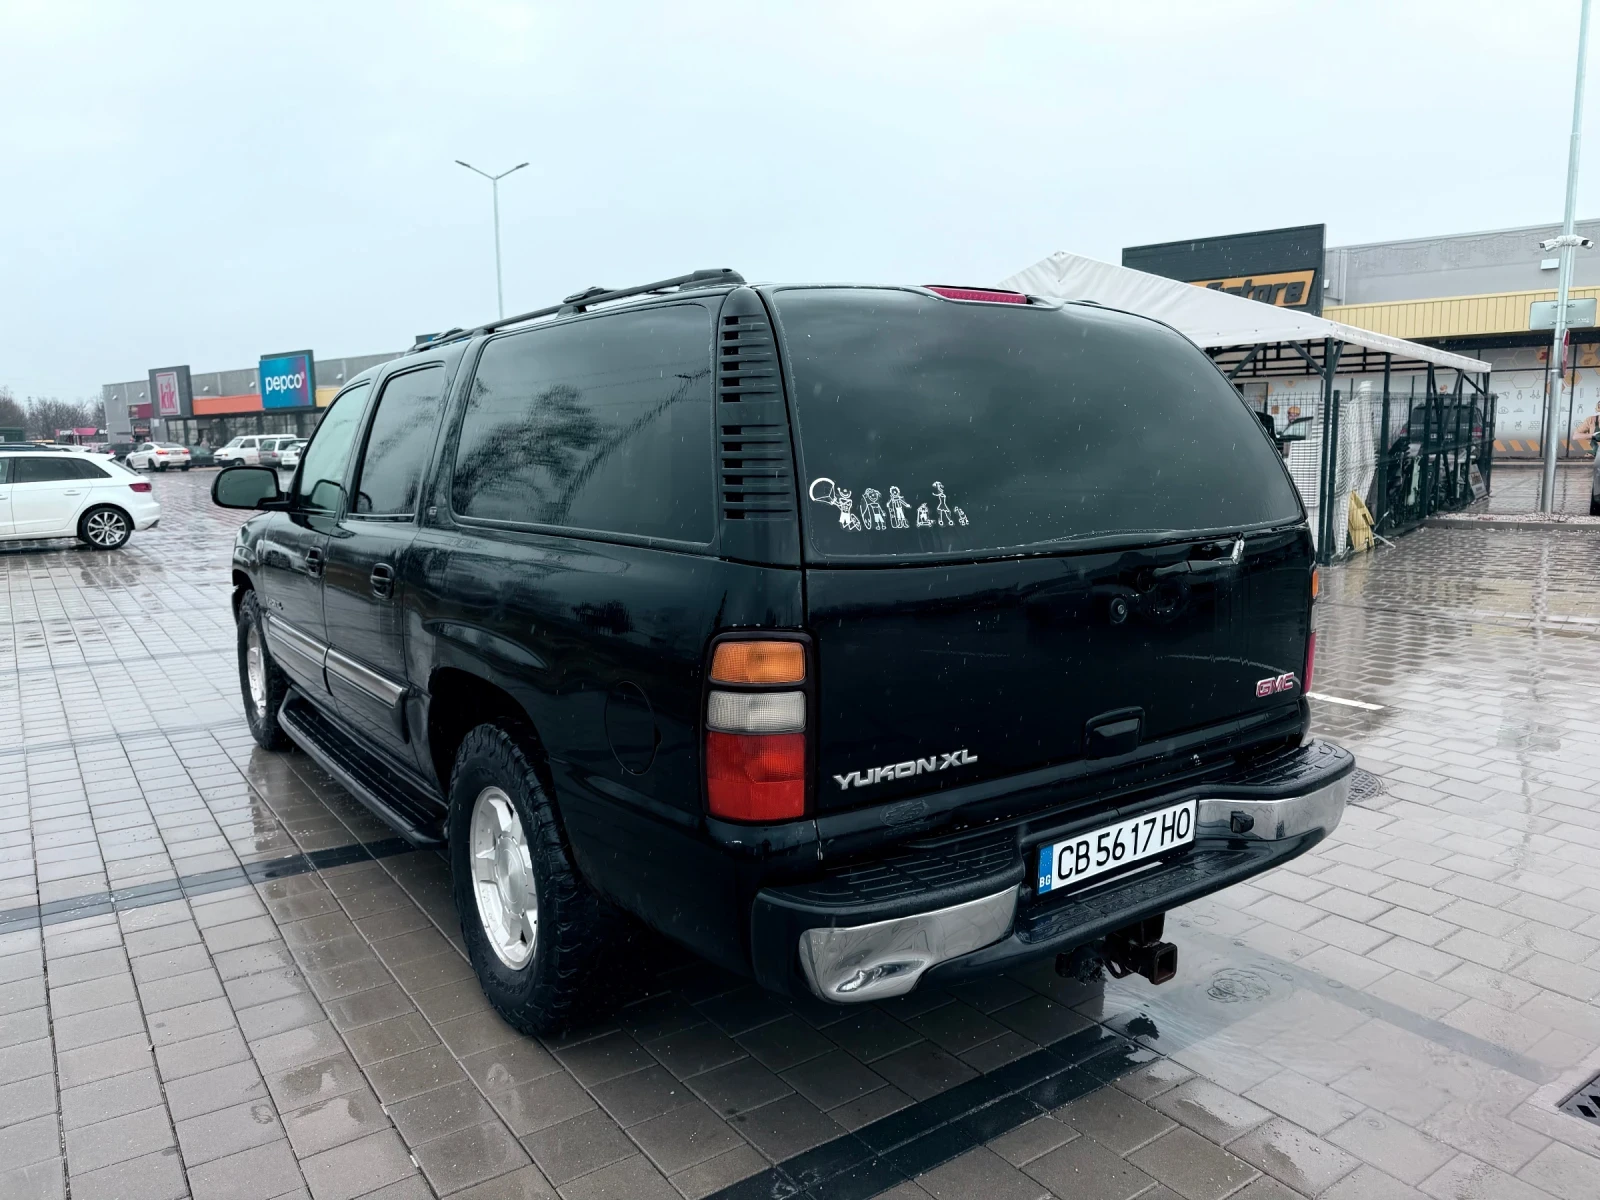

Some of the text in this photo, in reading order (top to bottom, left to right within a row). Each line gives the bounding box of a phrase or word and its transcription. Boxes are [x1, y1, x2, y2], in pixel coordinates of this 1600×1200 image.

[265, 373, 302, 395] pepco
[1256, 672, 1294, 697] GMC
[833, 749, 978, 790] YUKON XL
[1057, 807, 1191, 880] CB 5617 HO
[1039, 875, 1051, 888] BG
